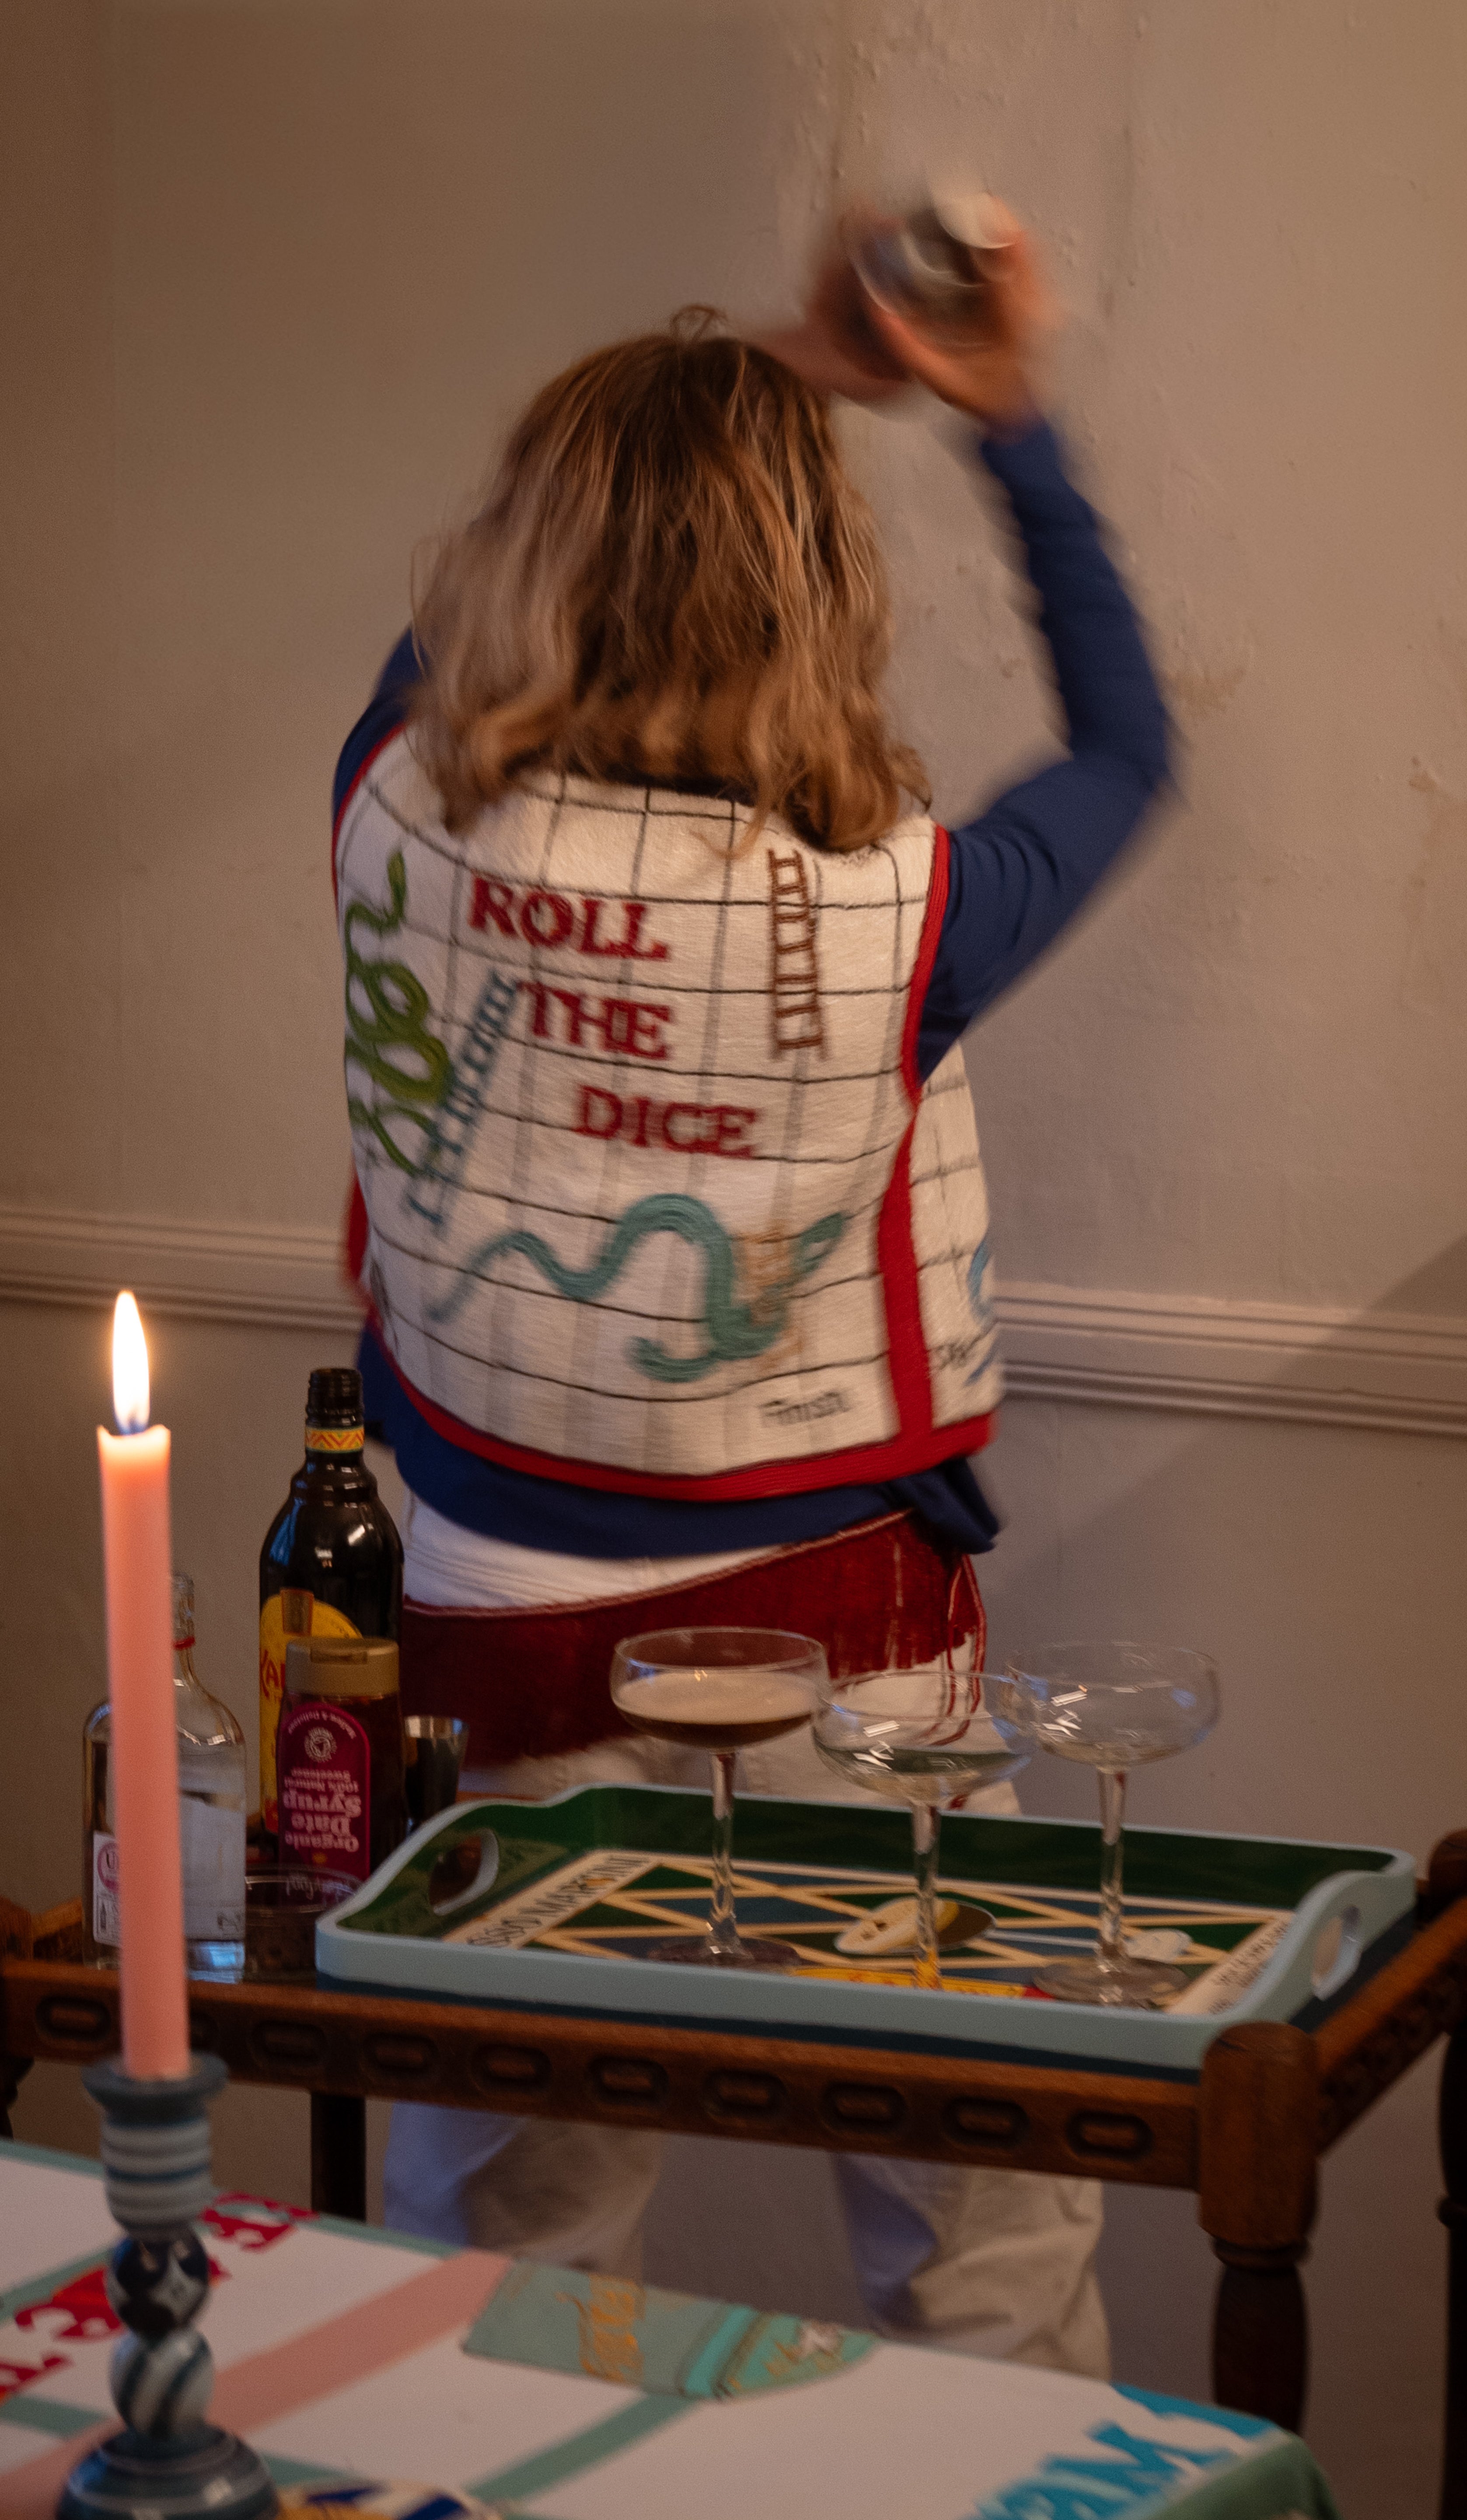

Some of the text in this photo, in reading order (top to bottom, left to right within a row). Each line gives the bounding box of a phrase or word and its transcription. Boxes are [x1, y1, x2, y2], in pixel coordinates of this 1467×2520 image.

[468, 873, 671, 961] ROLL
[516, 980, 674, 1061] THE
[573, 1083, 762, 1160] DICE
[283, 1788, 362, 1818] Syrup
[291, 1812, 352, 1837] Date
[285, 1830, 360, 1852] Organic
